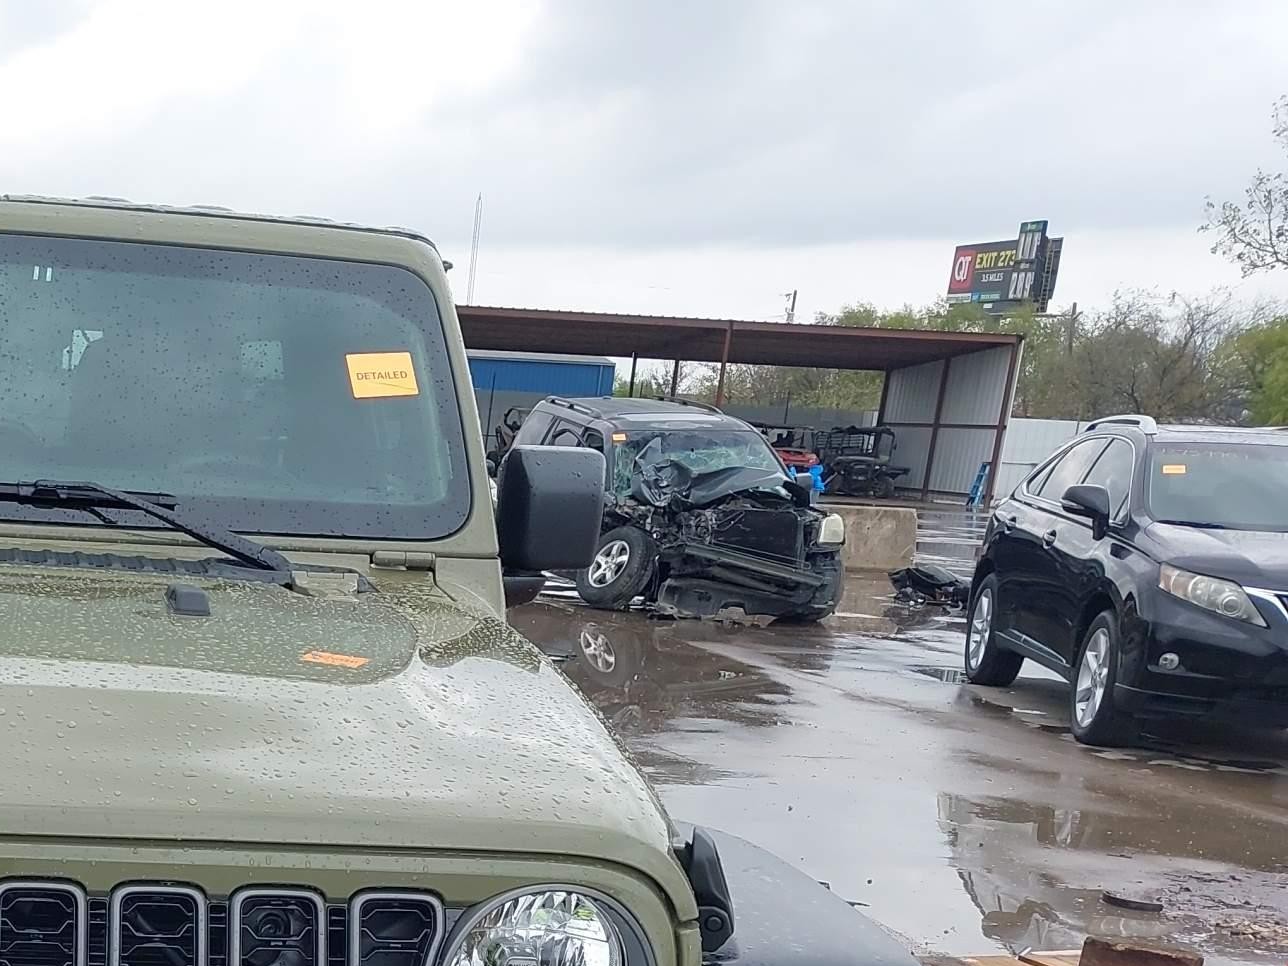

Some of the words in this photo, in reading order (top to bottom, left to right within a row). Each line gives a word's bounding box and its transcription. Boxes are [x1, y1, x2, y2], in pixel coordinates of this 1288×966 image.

[955, 256, 972, 282] QT
[975, 251, 998, 269] EXIT
[356, 370, 408, 381] DETAILED
